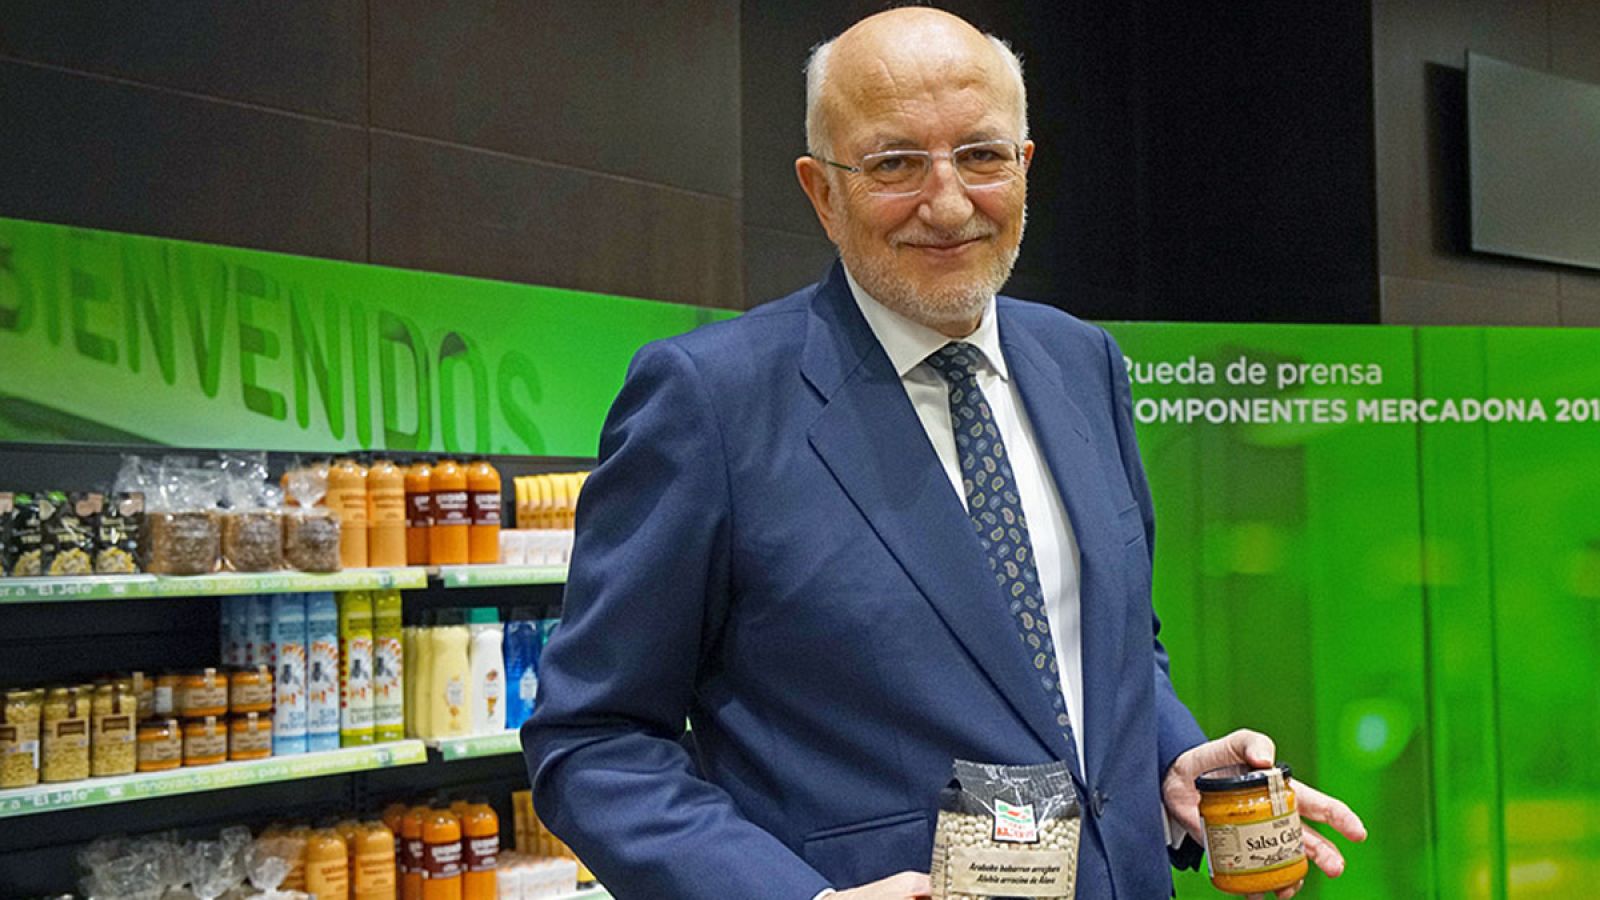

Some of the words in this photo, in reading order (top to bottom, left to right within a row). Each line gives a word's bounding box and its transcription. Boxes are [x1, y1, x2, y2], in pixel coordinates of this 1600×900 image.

[0, 231, 547, 453] BIENVENIDOS
[1226, 356, 1267, 385] de
[1278, 361, 1383, 390] prensa
[1132, 399, 1348, 424] OMPONENTES
[1357, 397, 1547, 423] MERCADONA
[1246, 836, 1279, 852] Salsa
